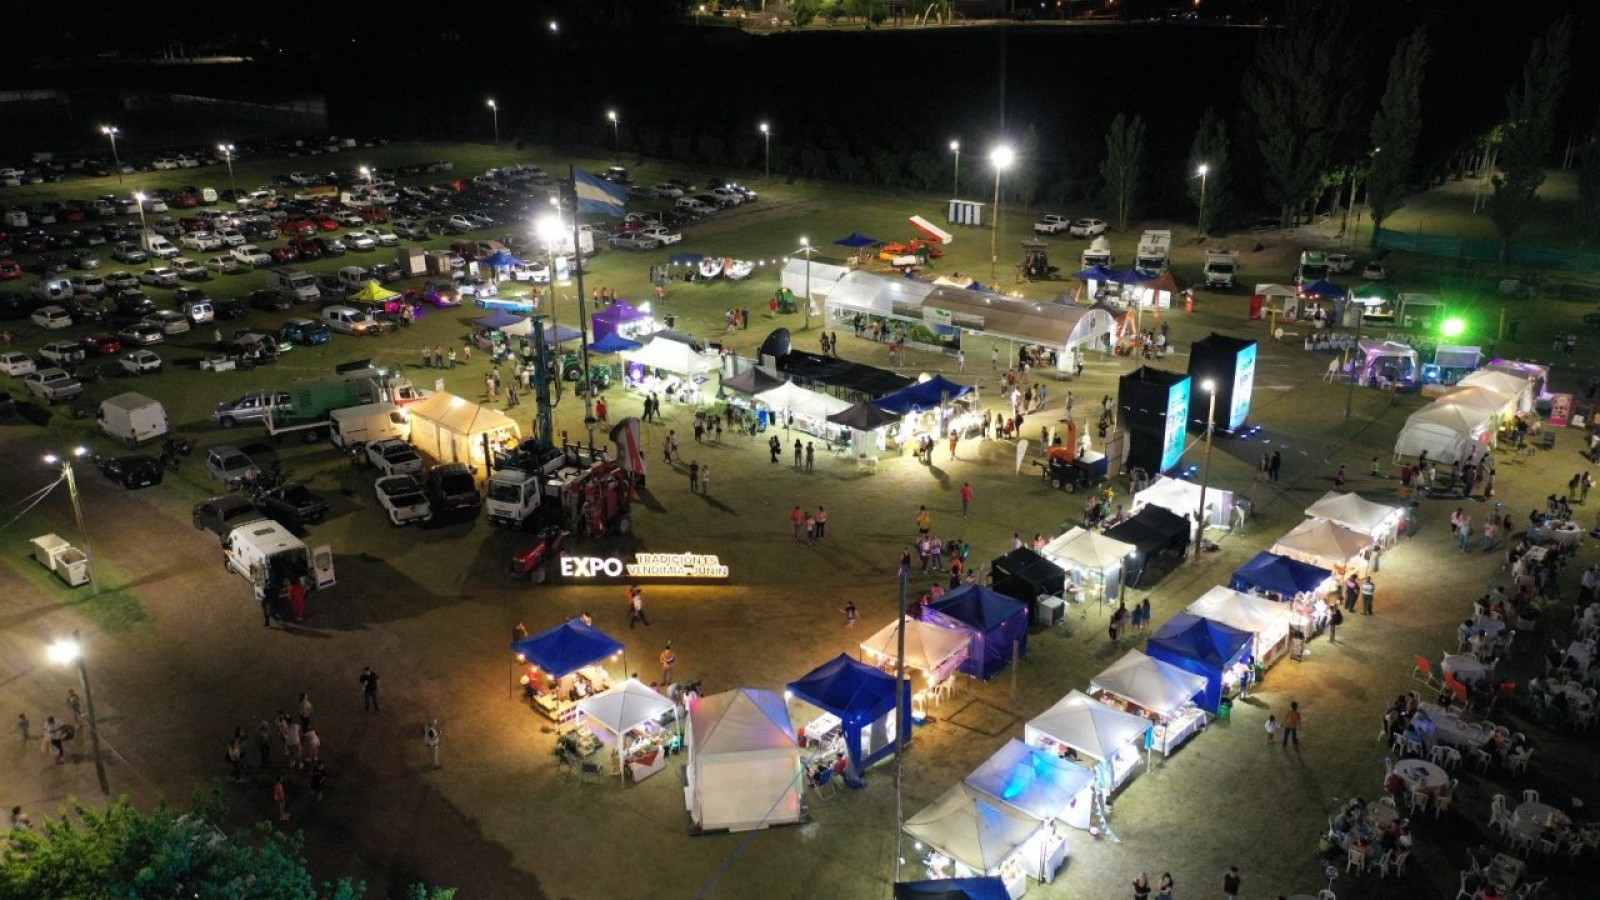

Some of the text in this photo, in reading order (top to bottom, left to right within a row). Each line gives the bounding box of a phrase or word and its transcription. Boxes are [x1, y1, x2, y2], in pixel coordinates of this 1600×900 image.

[704, 555, 718, 565] ES
[560, 557, 623, 577] EXPO
[628, 565, 685, 576] VENDIMIA
